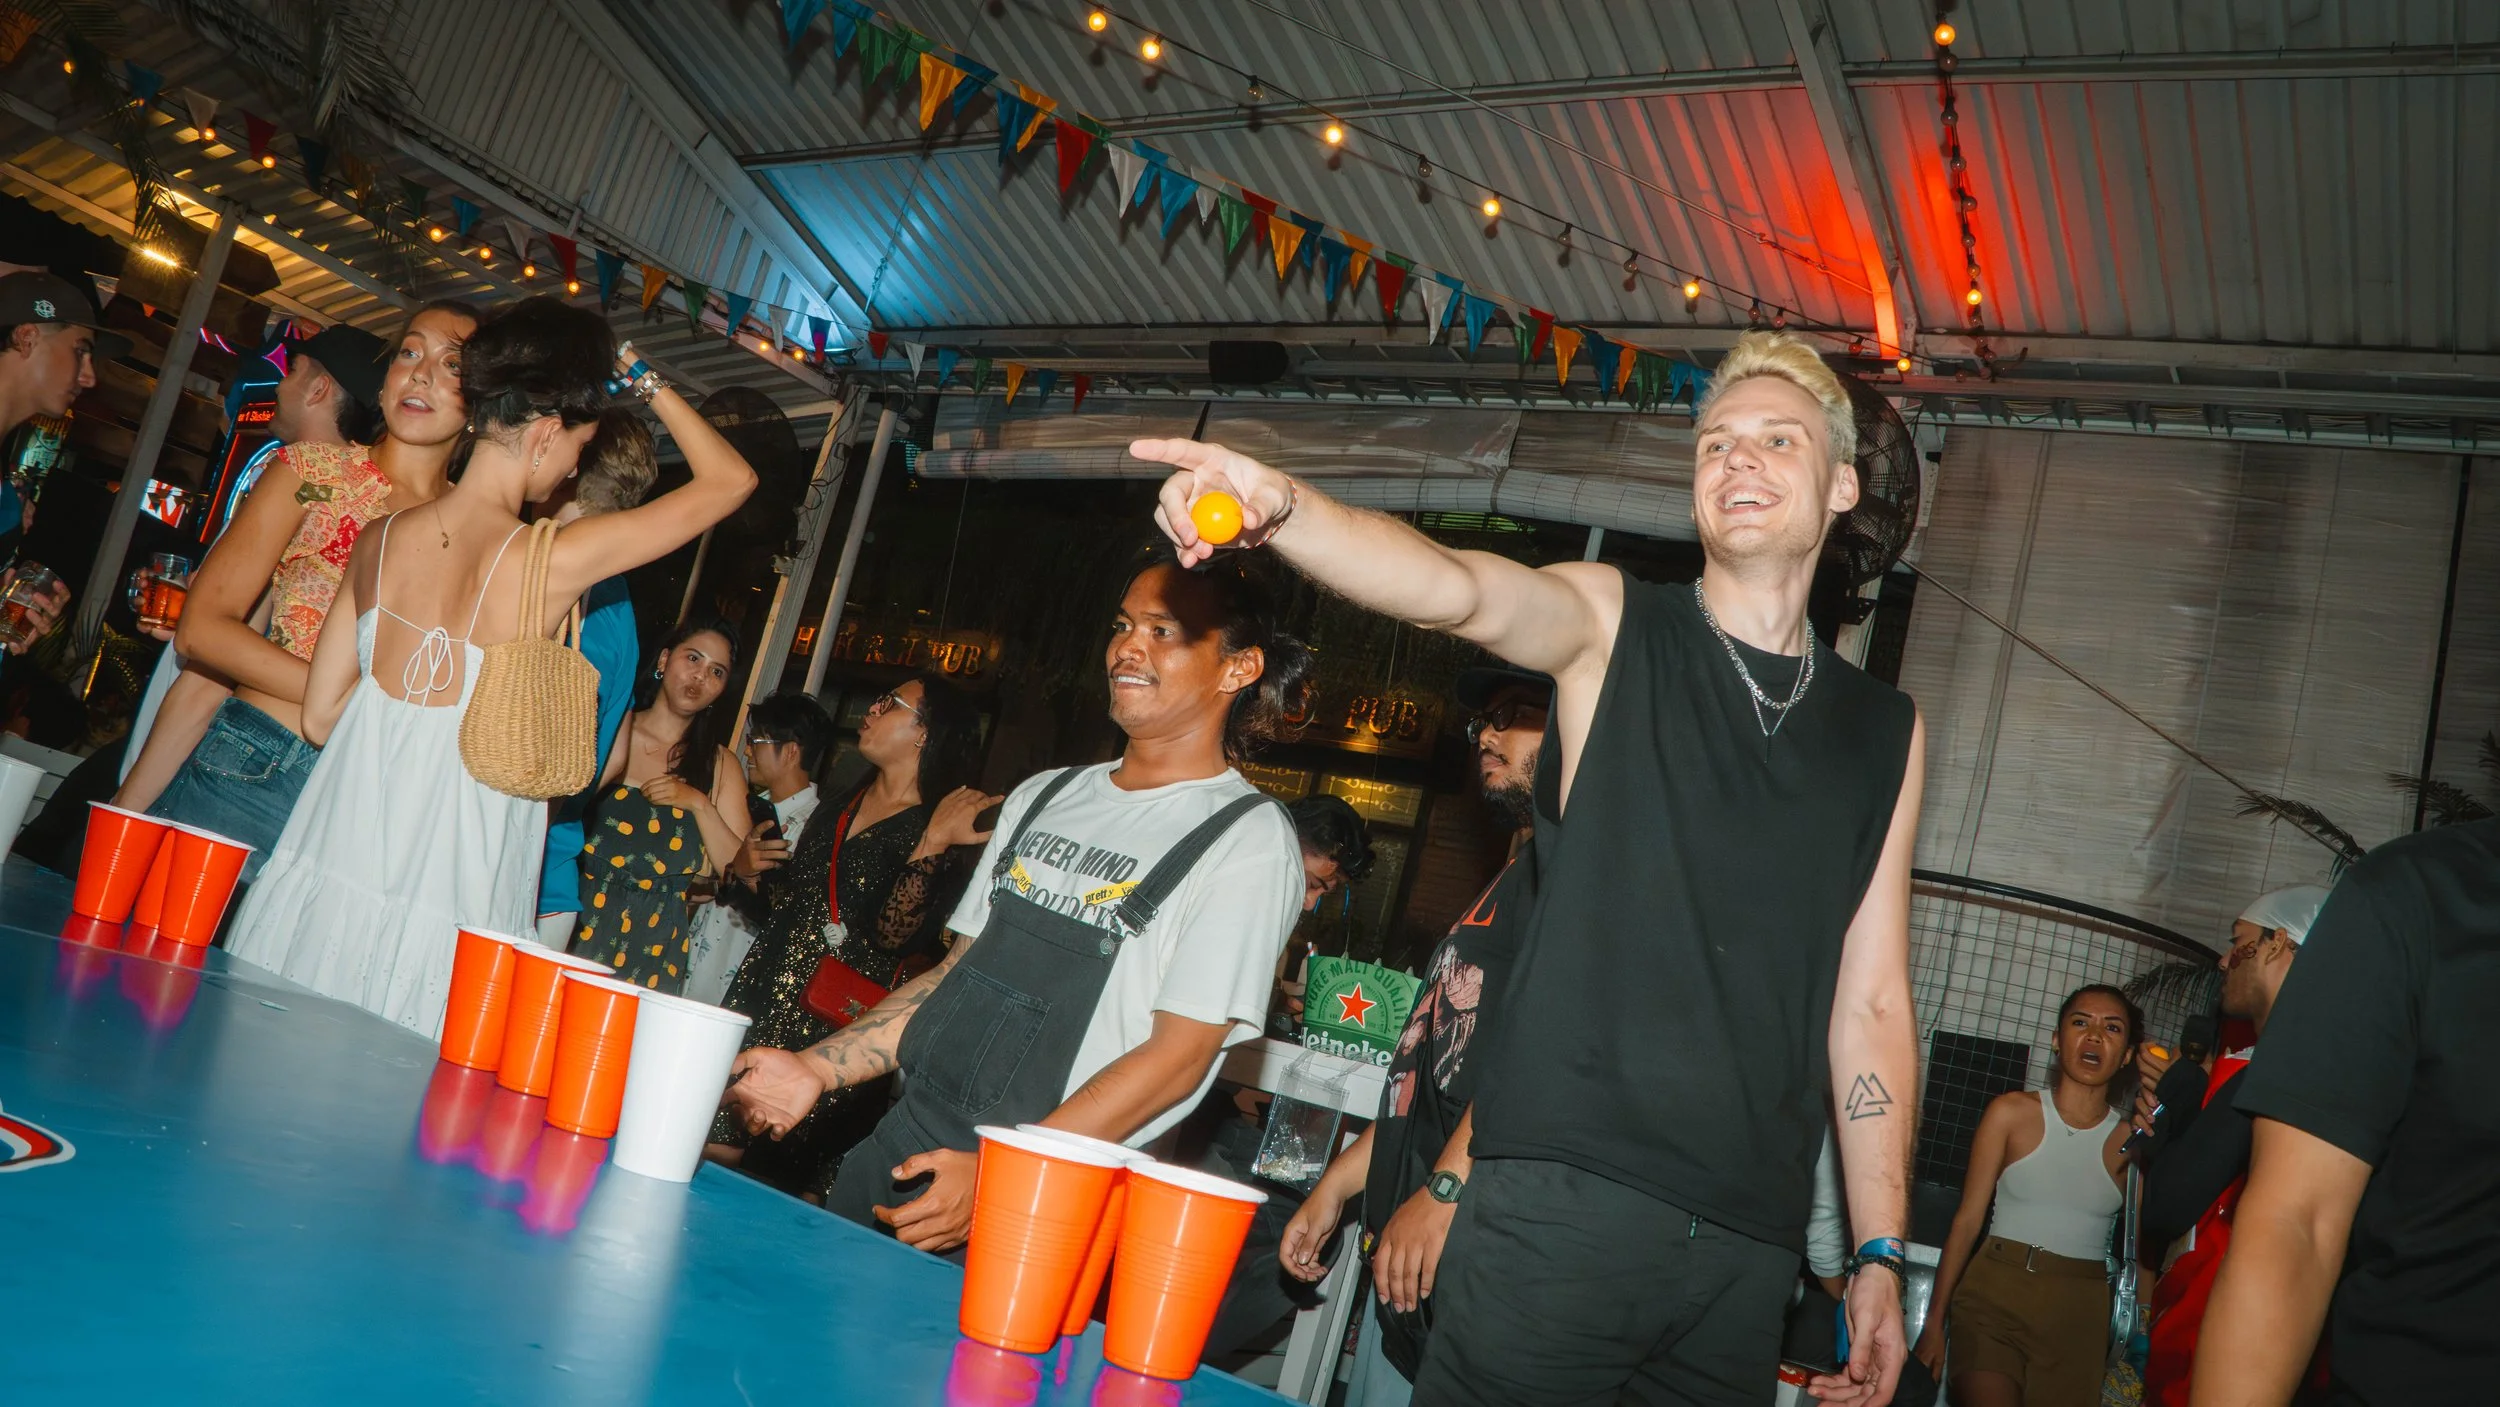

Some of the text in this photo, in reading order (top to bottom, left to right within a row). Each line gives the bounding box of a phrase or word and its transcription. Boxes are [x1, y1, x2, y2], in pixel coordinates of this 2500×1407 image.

[928, 639, 983, 675] PUB
[1344, 695, 1417, 737] PUB
[1016, 830, 1139, 884] NEVER MIND
[1085, 888, 1114, 903] pretty
[1306, 970, 1330, 1010] PURE
[1303, 1027, 1393, 1067] eineke
